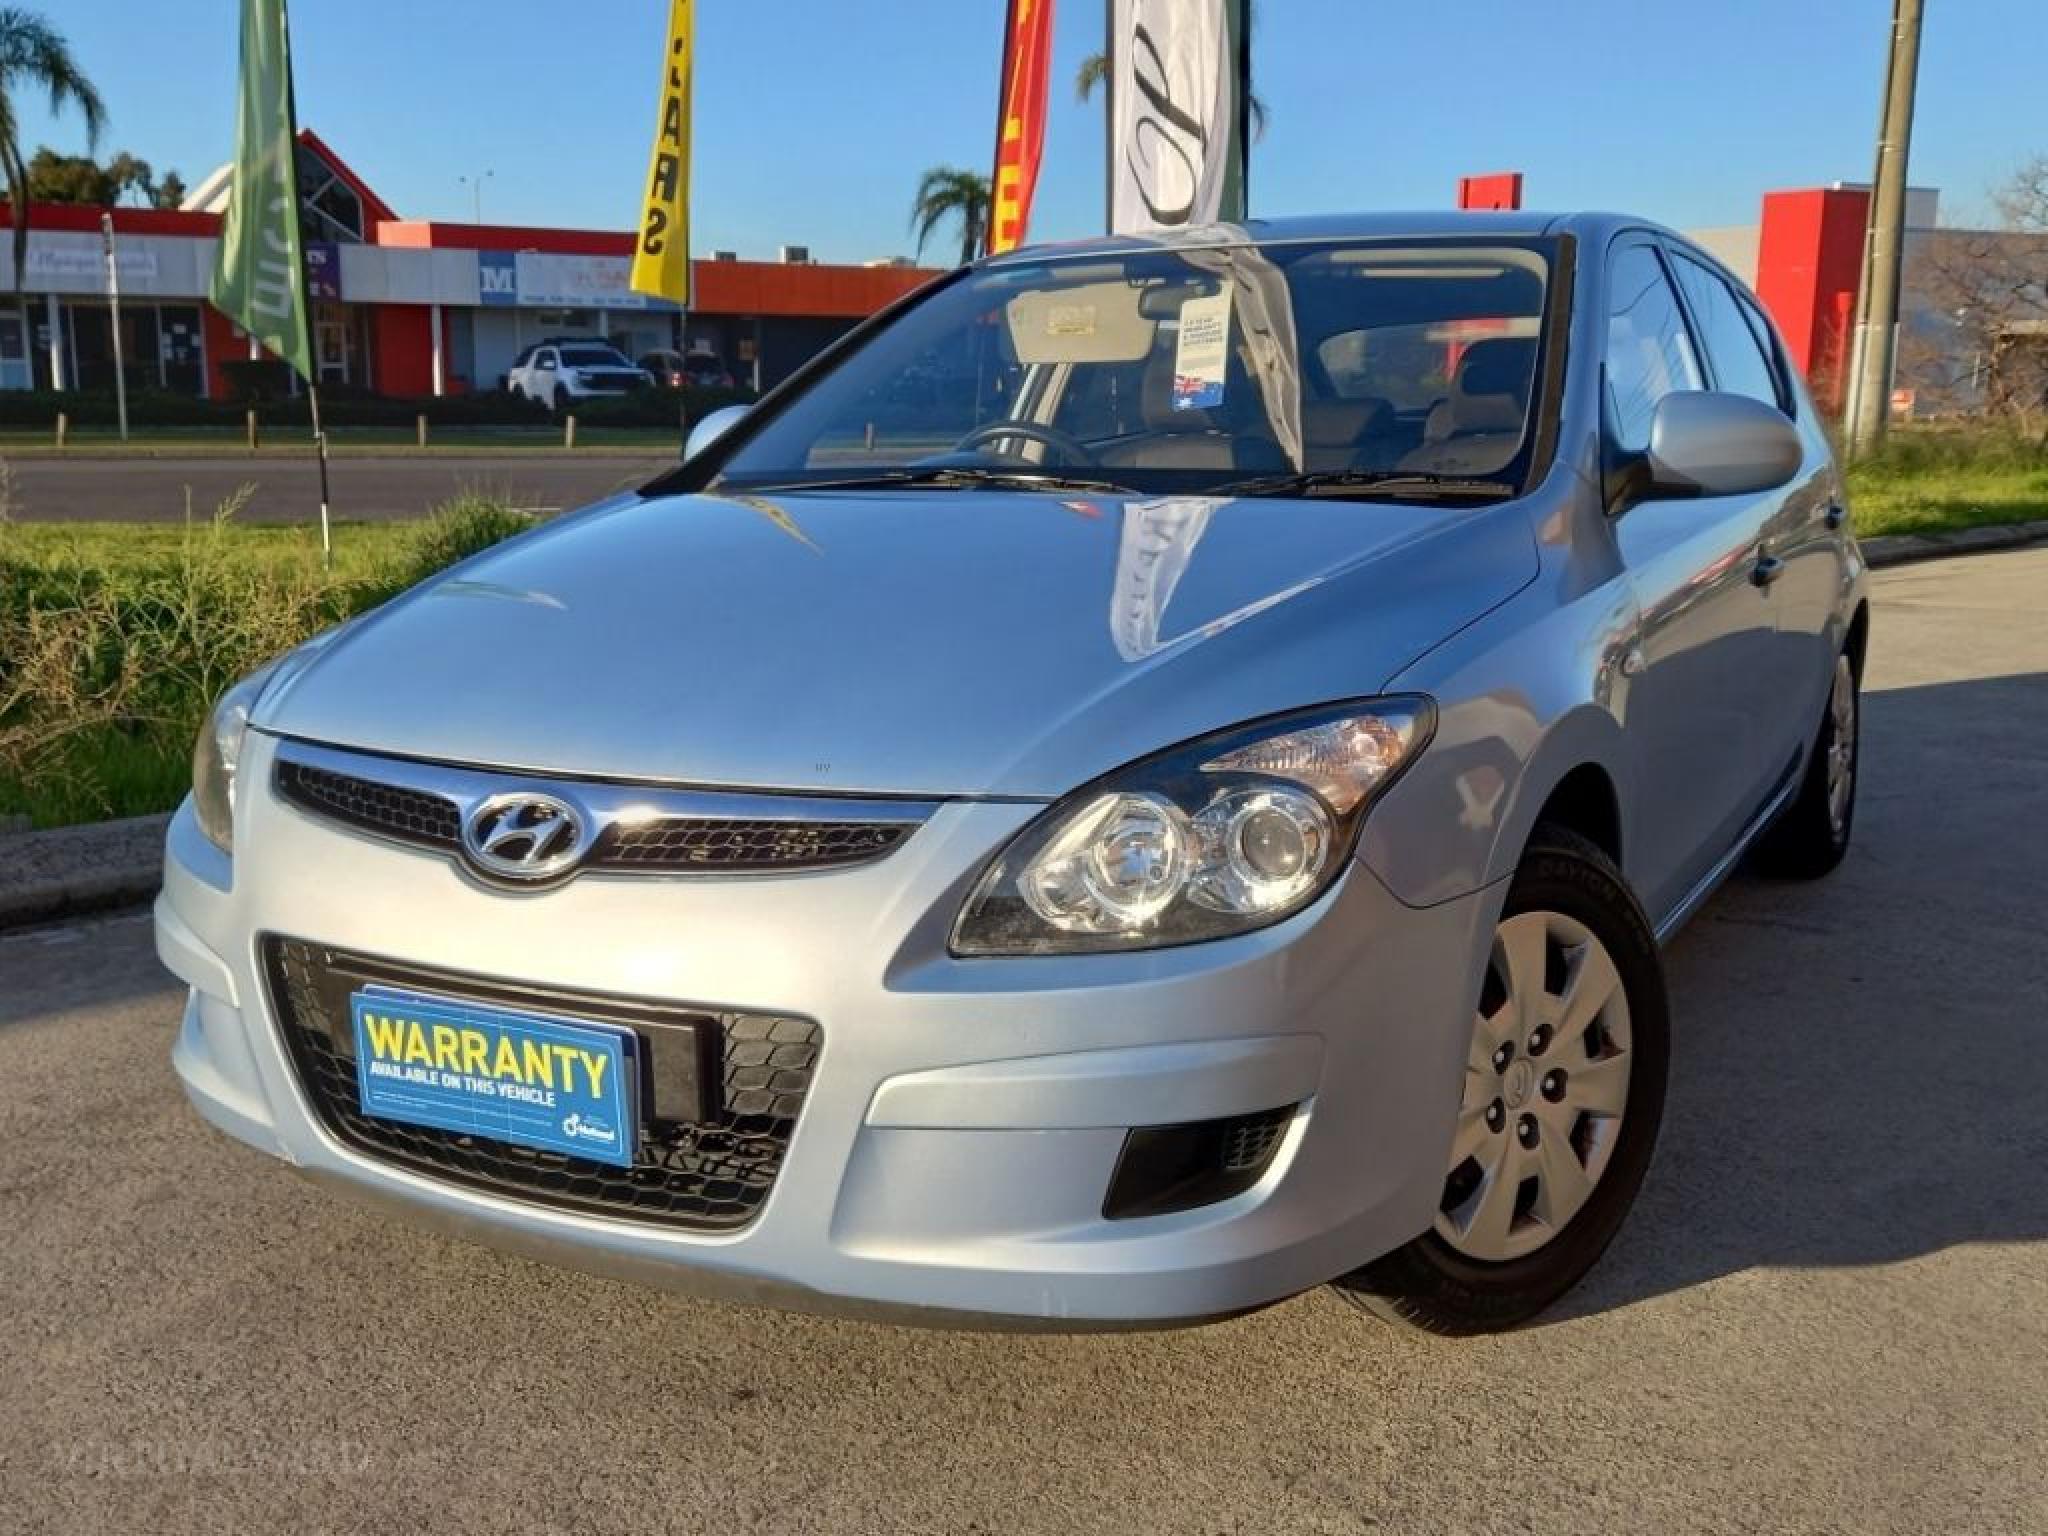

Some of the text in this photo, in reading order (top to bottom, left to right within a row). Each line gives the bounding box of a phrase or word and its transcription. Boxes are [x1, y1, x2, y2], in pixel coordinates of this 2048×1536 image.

[364, 1013, 608, 1098] WARRANTY
[371, 1061, 439, 1085] AVAILABLE
[441, 1073, 461, 1089] ON
[465, 1076, 496, 1095] THIS
[497, 1081, 557, 1108] VEHICLE
